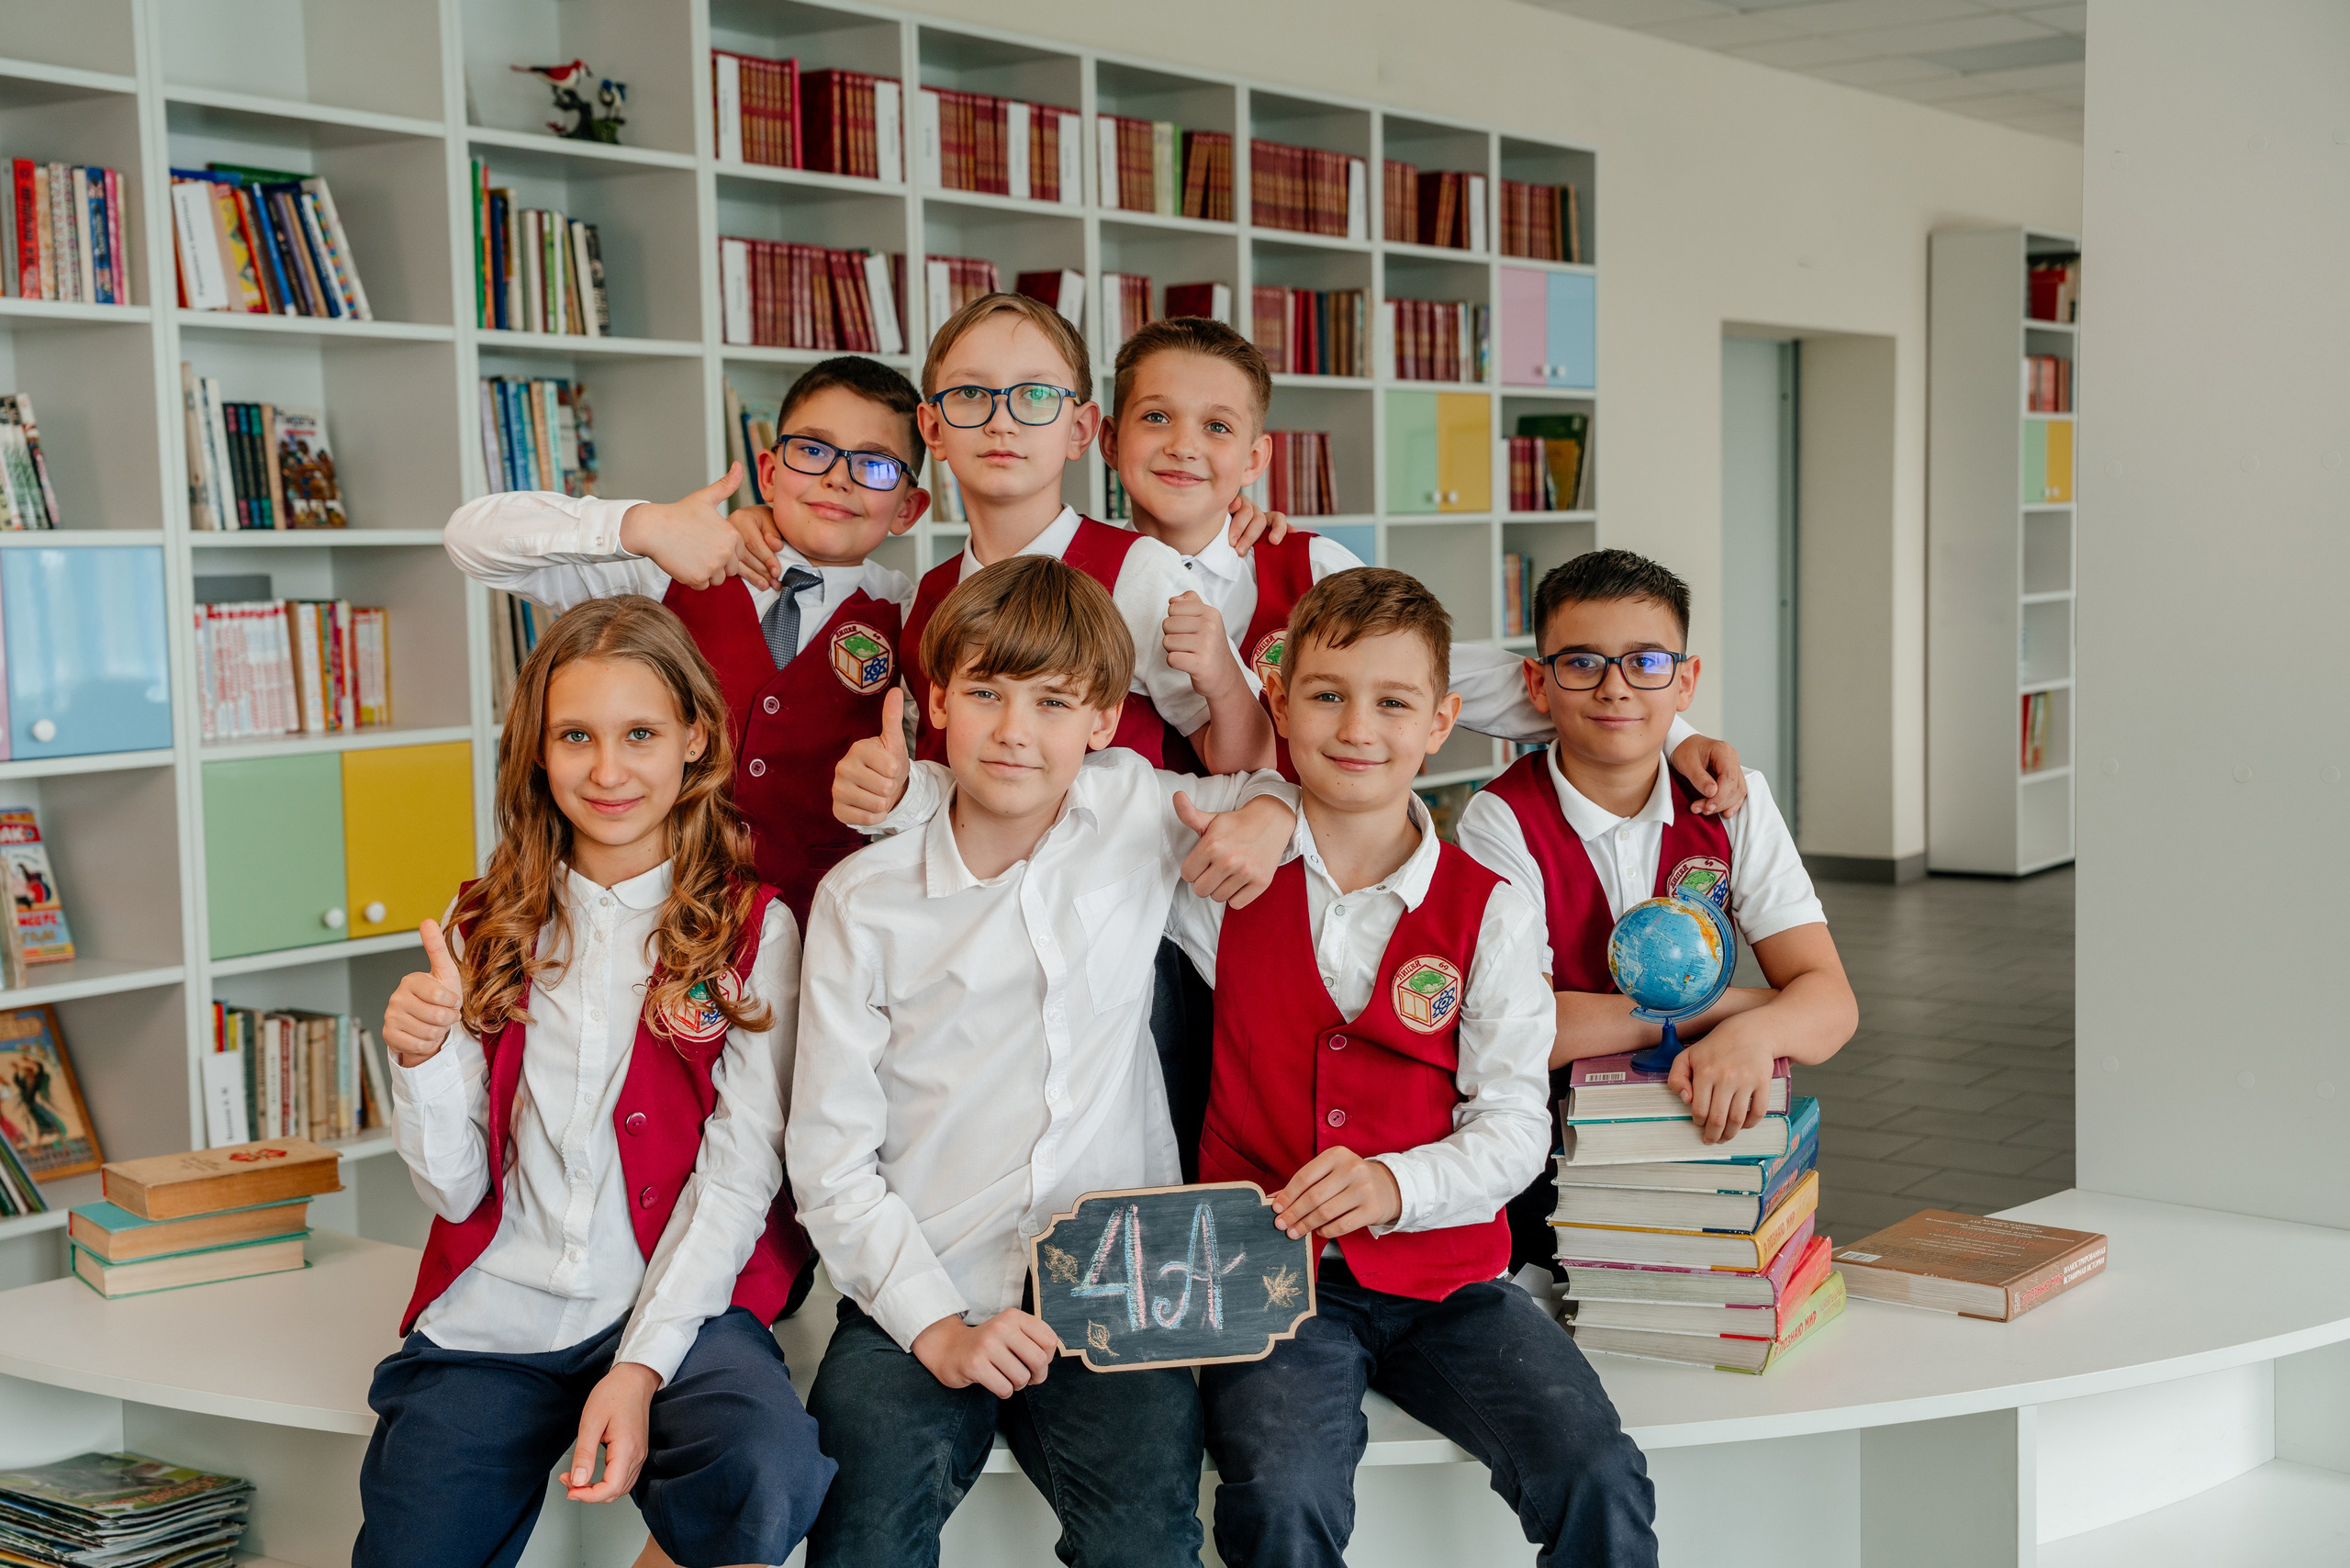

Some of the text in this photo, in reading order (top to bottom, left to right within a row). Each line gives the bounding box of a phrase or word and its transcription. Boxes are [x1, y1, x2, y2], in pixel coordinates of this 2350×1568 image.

[1397, 959, 1449, 981] ЛИЦЕЙ 69
[1785, 1211, 1796, 1230] МИР
[1779, 1322, 1804, 1355] ПОЗНАЮ
[1805, 1310, 1818, 1331] МИР
